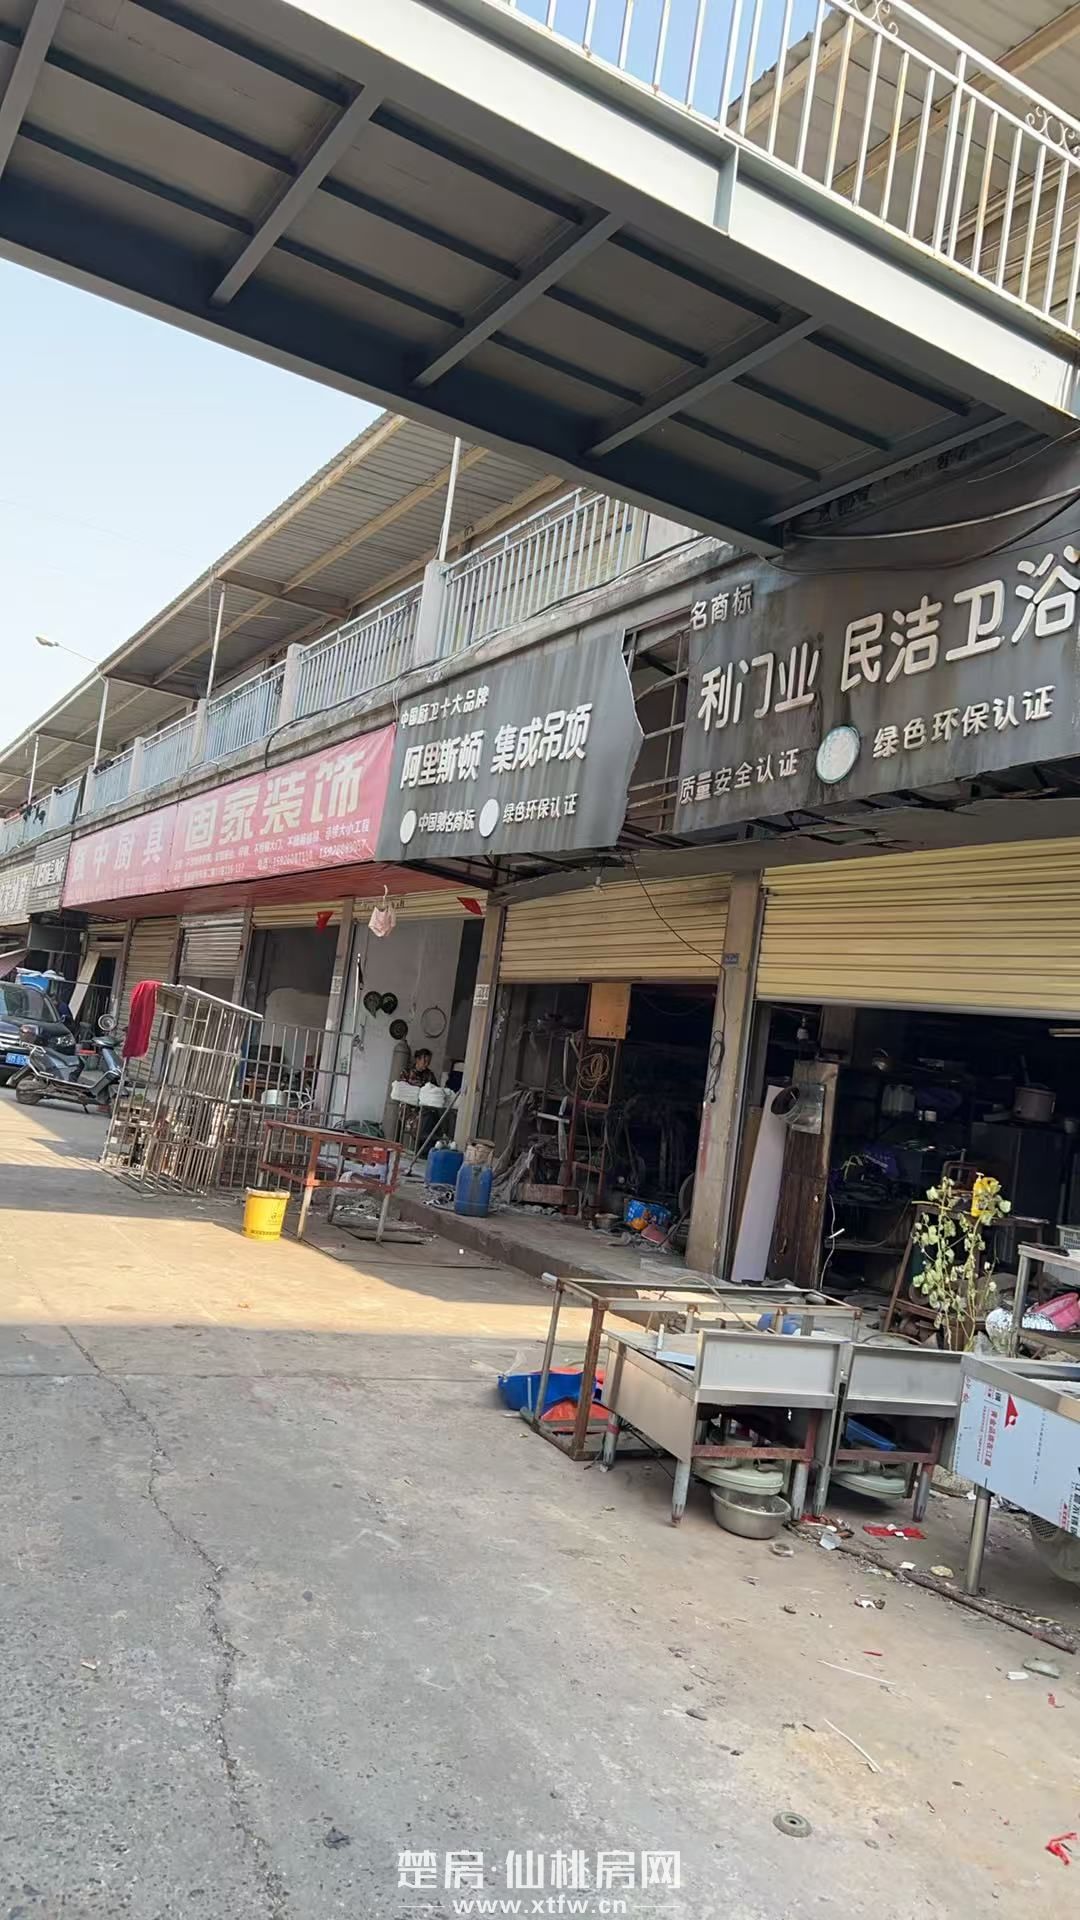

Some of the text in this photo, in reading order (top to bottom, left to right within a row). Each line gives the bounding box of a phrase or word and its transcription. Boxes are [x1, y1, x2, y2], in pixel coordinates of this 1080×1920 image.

[689, 583, 755, 631] 名商标
[698, 545, 1080, 732] 利门业 民洁卫浴
[400, 685, 490, 728] 中国厨卫十大品牌
[872, 684, 1056, 759] 绿色环保认证
[400, 703, 593, 789] 阿里斯顿 集成吊顶
[680, 748, 801, 805] 质量安全认证
[502, 793, 579, 824] 绿色环保认证
